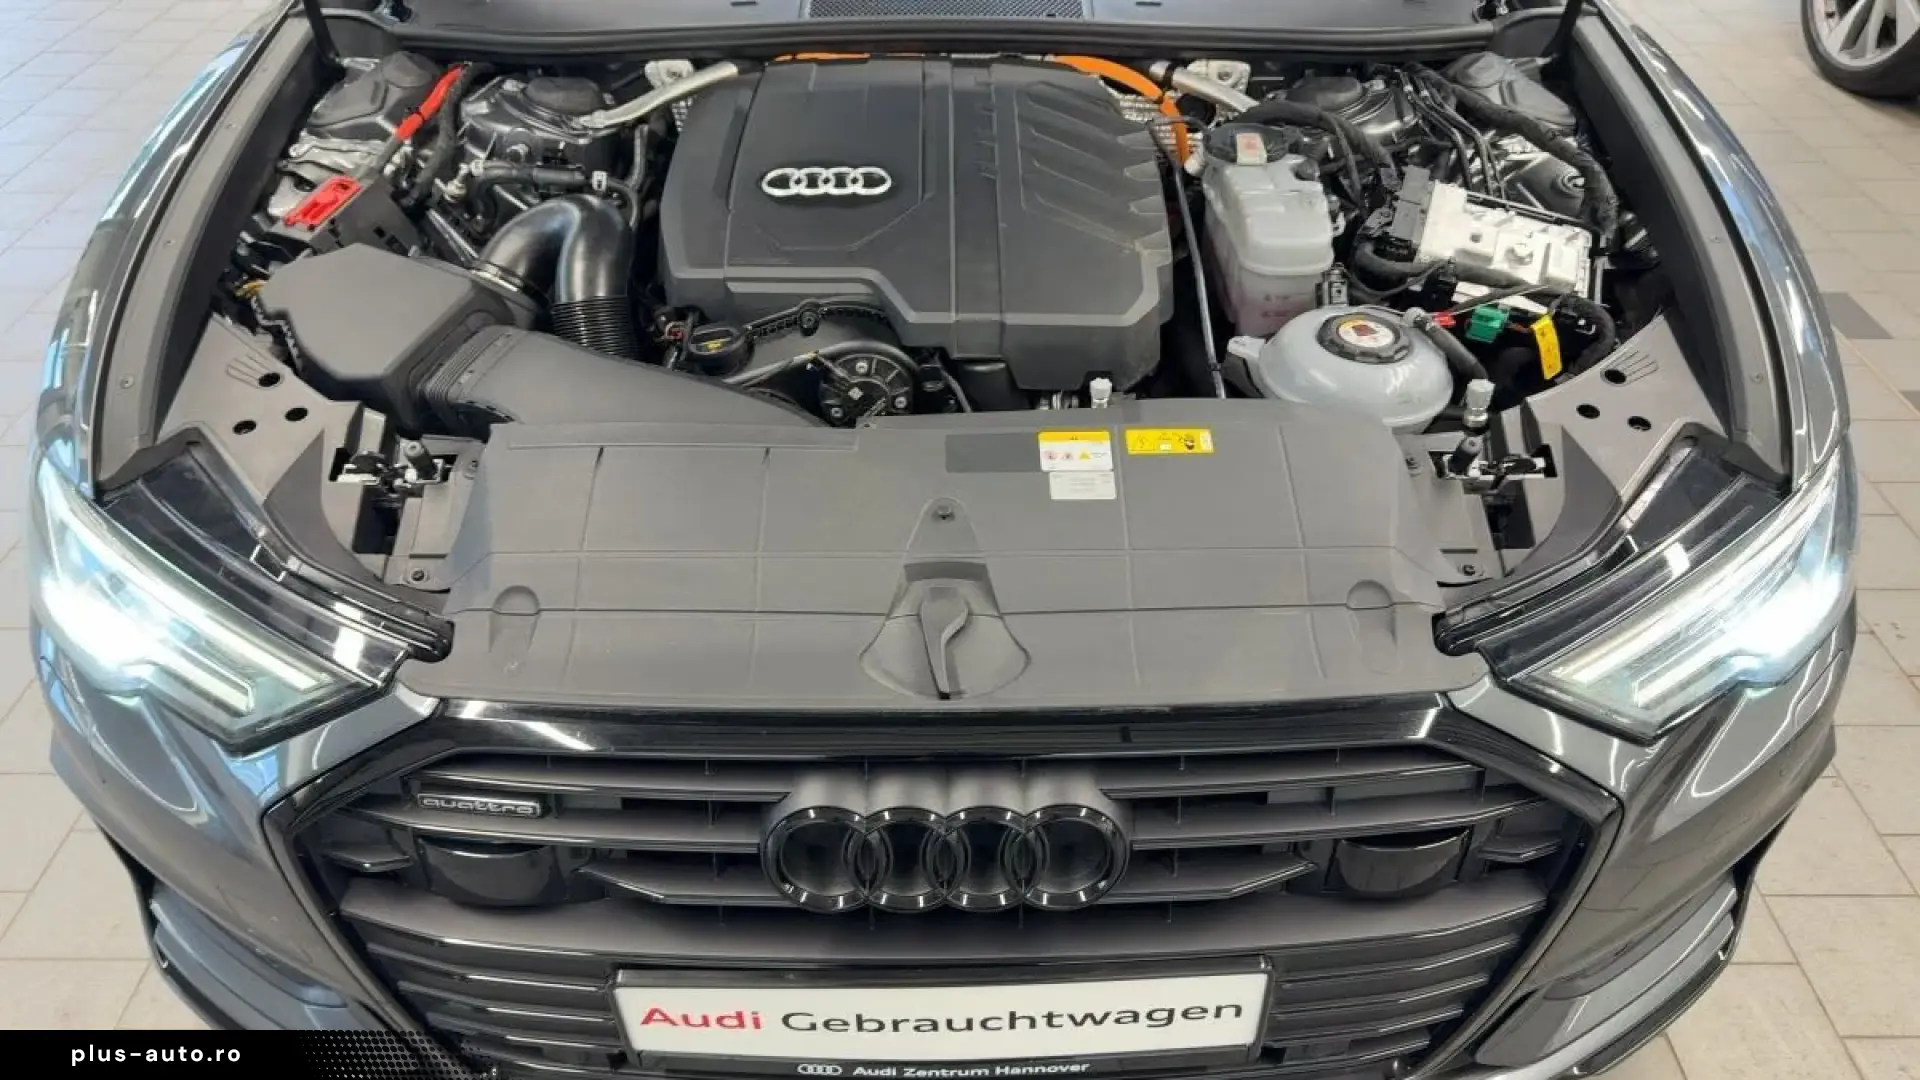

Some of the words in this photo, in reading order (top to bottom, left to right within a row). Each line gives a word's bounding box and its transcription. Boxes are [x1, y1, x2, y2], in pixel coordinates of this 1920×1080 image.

[423, 797, 534, 814] quattro
[640, 1007, 762, 1030] Audi
[781, 1003, 1243, 1033] Gebrauchtwagen
[852, 1066, 897, 1076] Audi
[903, 1067, 990, 1078] Zentrum
[995, 1062, 1091, 1076] Hannover
